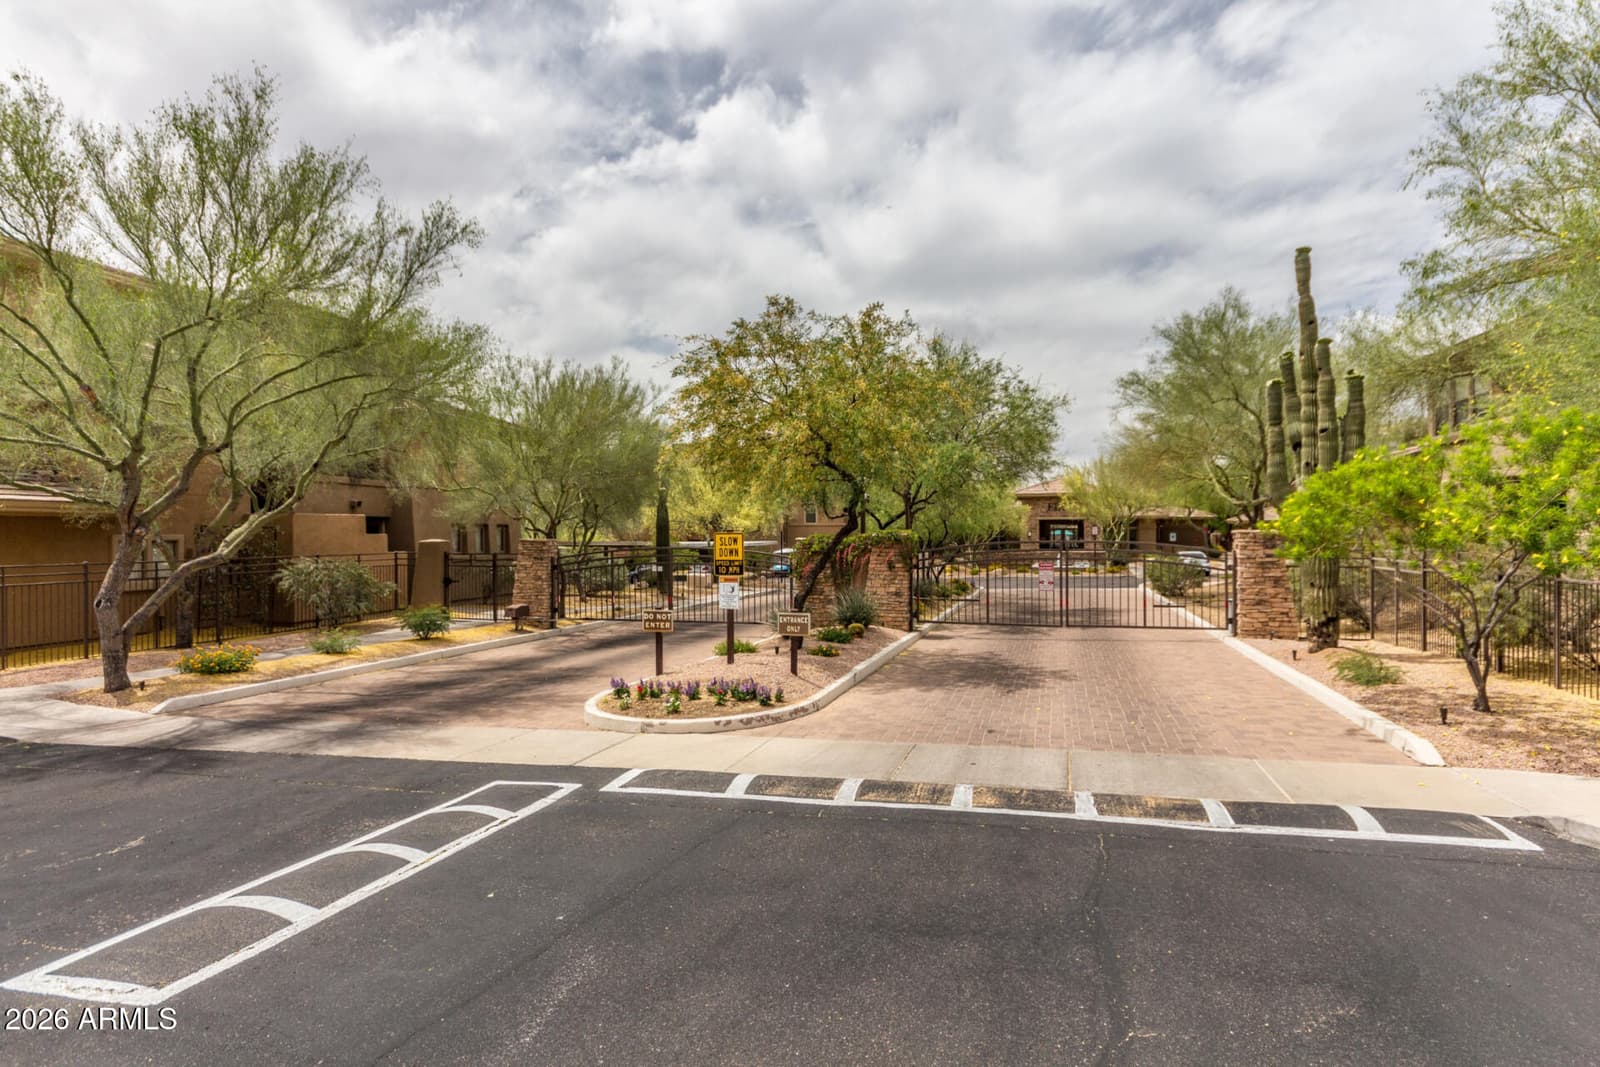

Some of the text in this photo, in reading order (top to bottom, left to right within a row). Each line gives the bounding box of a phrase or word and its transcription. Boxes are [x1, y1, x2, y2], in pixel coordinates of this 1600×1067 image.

[719, 536, 738, 546] SLOW
[719, 547, 739, 557] DOWN
[779, 616, 808, 624] ENTRANCE
[786, 625, 800, 633] ONLY
